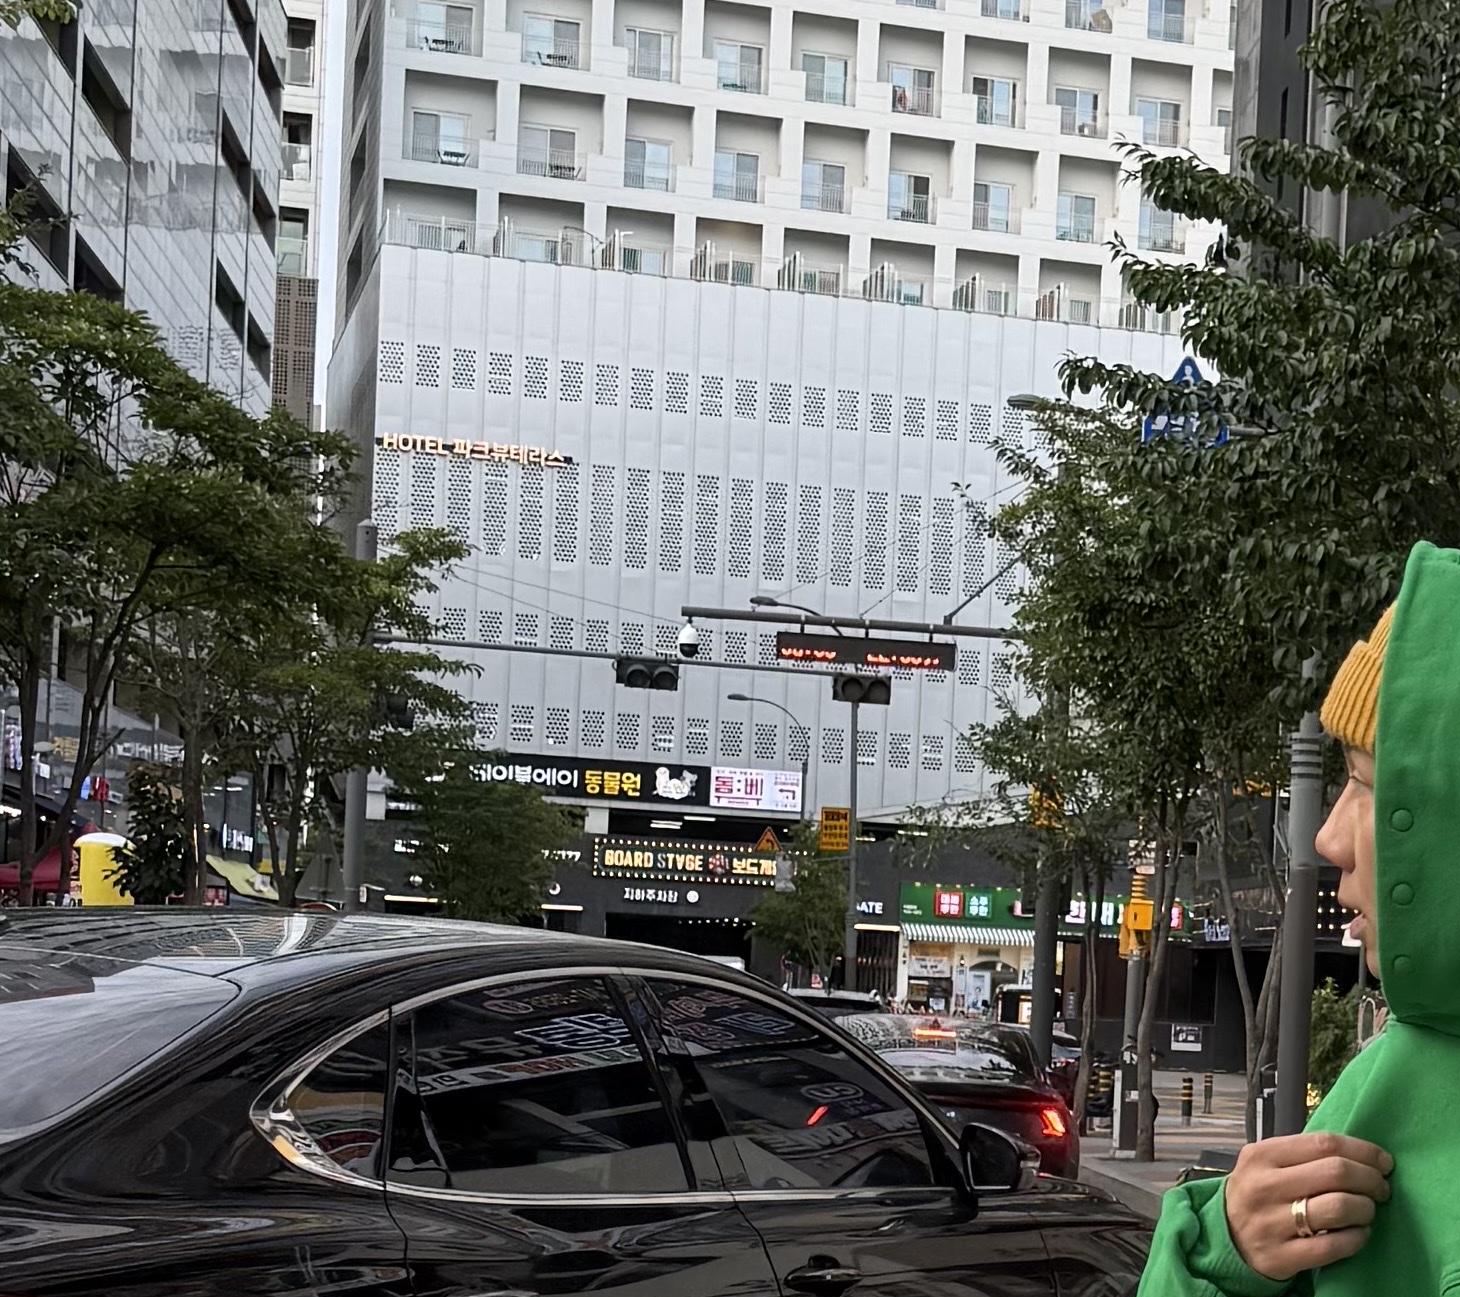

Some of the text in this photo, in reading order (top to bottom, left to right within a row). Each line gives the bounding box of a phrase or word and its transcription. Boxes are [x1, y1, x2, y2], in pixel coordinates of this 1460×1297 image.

[382, 431, 568, 468] HOTEL 파크뷰테라스
[584, 768, 642, 797] 동물원
[604, 849, 654, 869] BOARD
[732, 857, 778, 876] 보드게
[624, 886, 679, 903] 지하주차장
